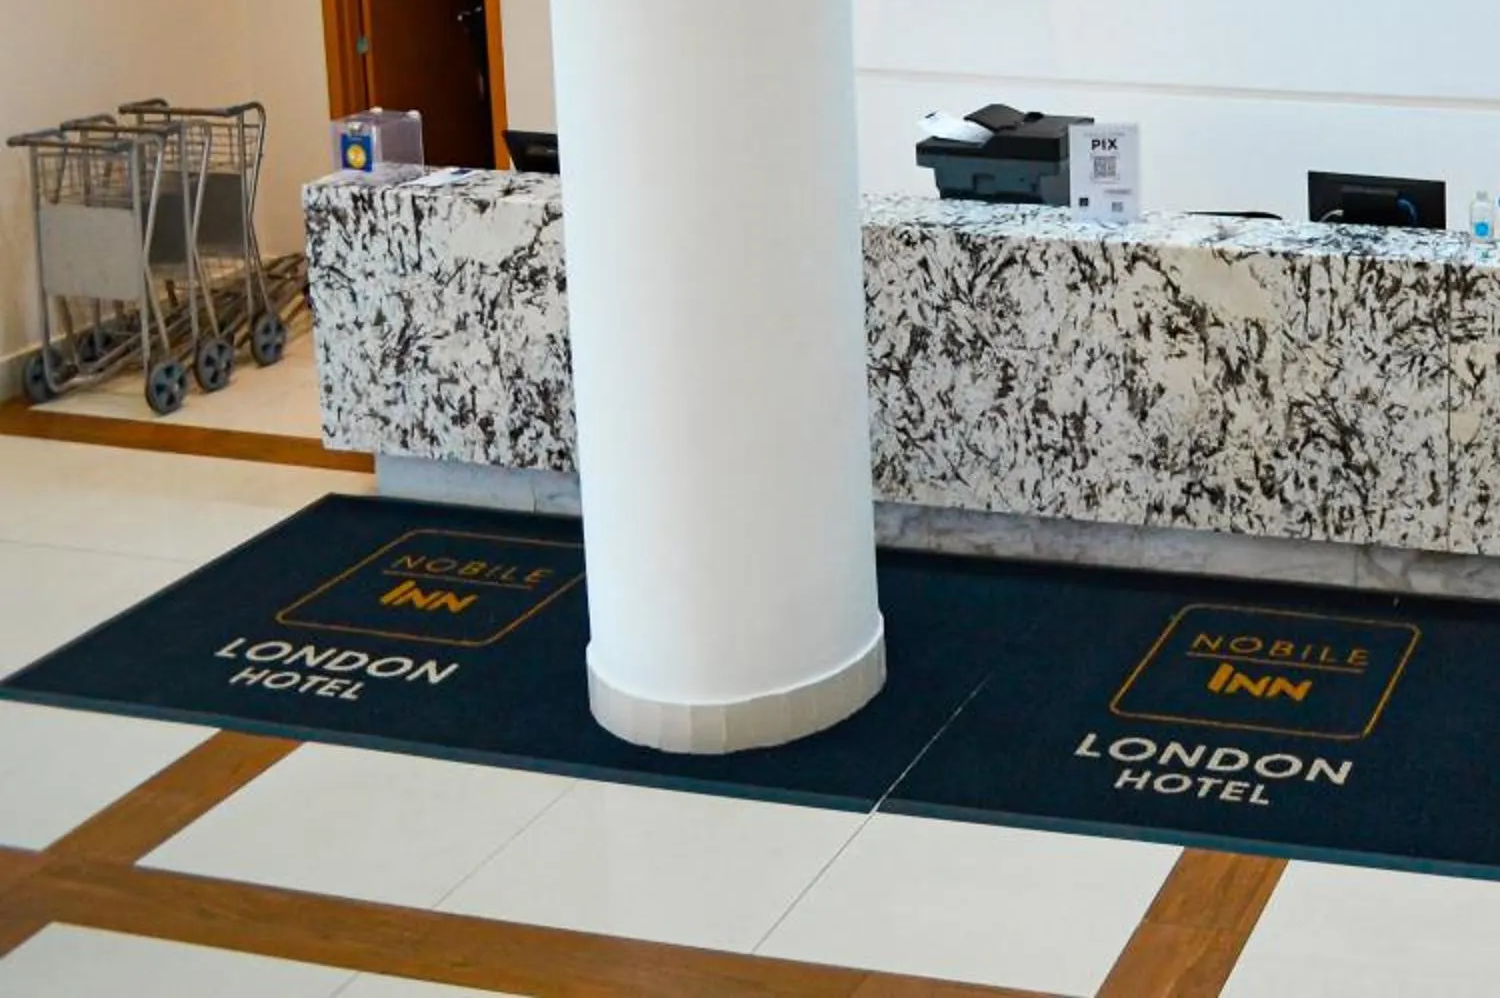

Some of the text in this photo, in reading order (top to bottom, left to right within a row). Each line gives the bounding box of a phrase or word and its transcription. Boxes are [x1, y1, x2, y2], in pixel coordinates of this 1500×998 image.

[1091, 137, 1118, 151] PIX
[391, 555, 555, 584] NOBILE
[379, 579, 478, 615] INN
[214, 637, 459, 684] LONDON
[1192, 633, 1371, 667] NOBILE
[229, 667, 365, 700] HOTEL
[1206, 662, 1313, 701] INN
[1074, 733, 1353, 785] LONDON
[1114, 768, 1270, 805] HOTEL
